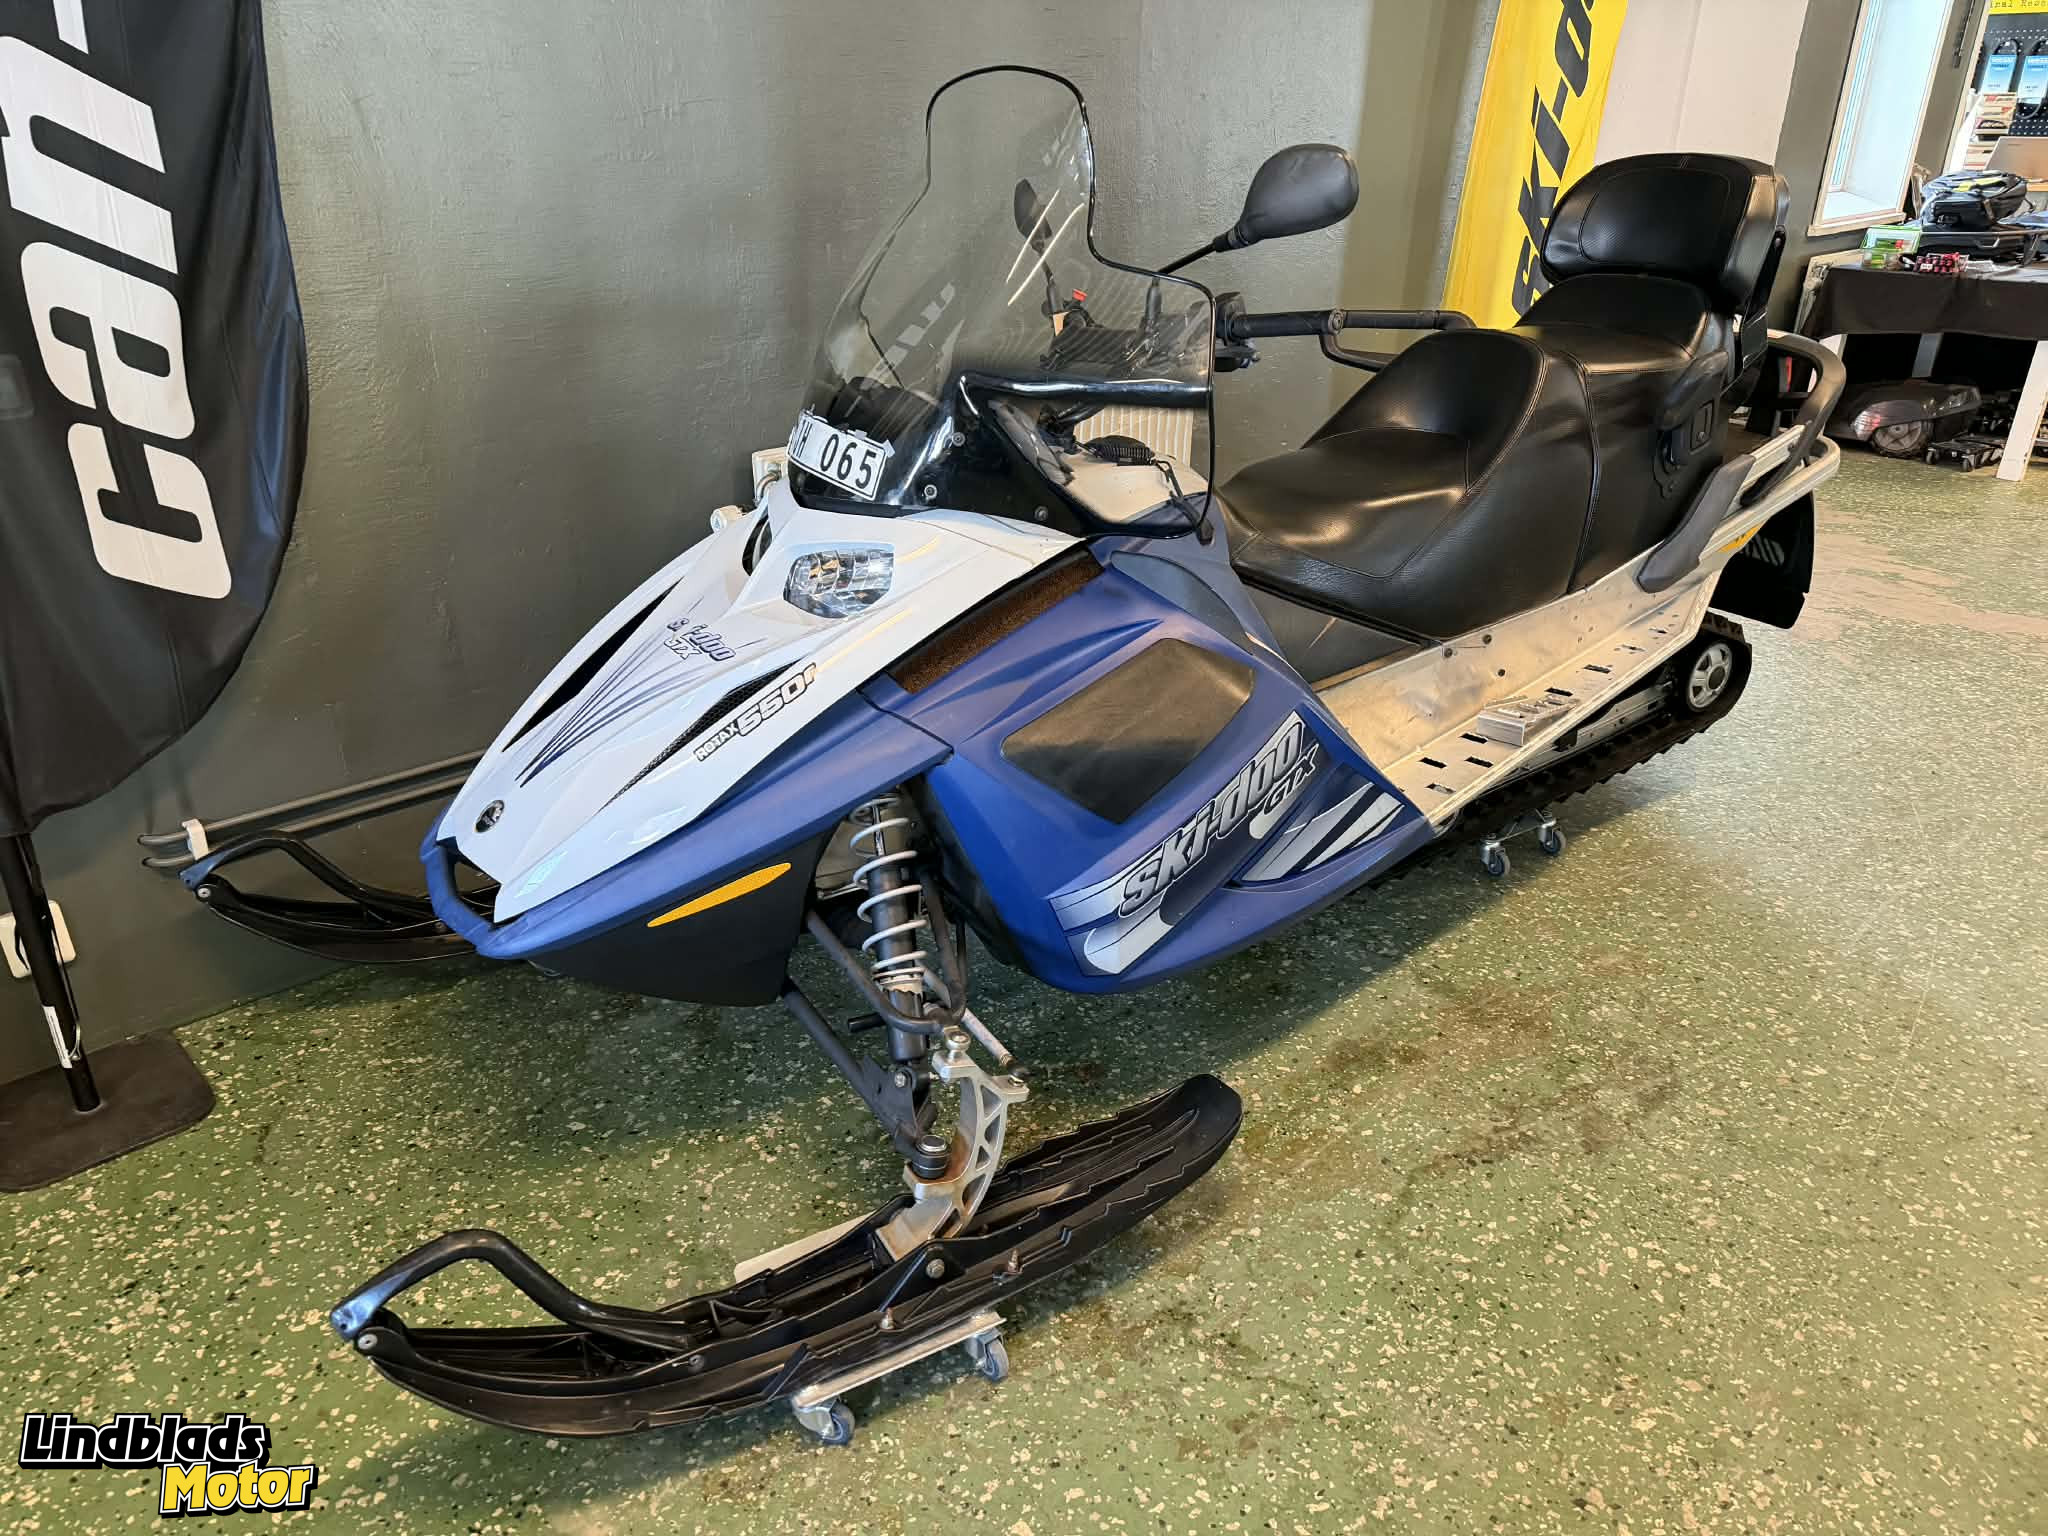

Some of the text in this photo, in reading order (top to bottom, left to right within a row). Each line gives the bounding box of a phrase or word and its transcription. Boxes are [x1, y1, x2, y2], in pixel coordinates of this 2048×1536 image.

[820, 433, 876, 489] 065
[694, 721, 740, 761] ROTAX
[1263, 742, 1319, 814] GTX
